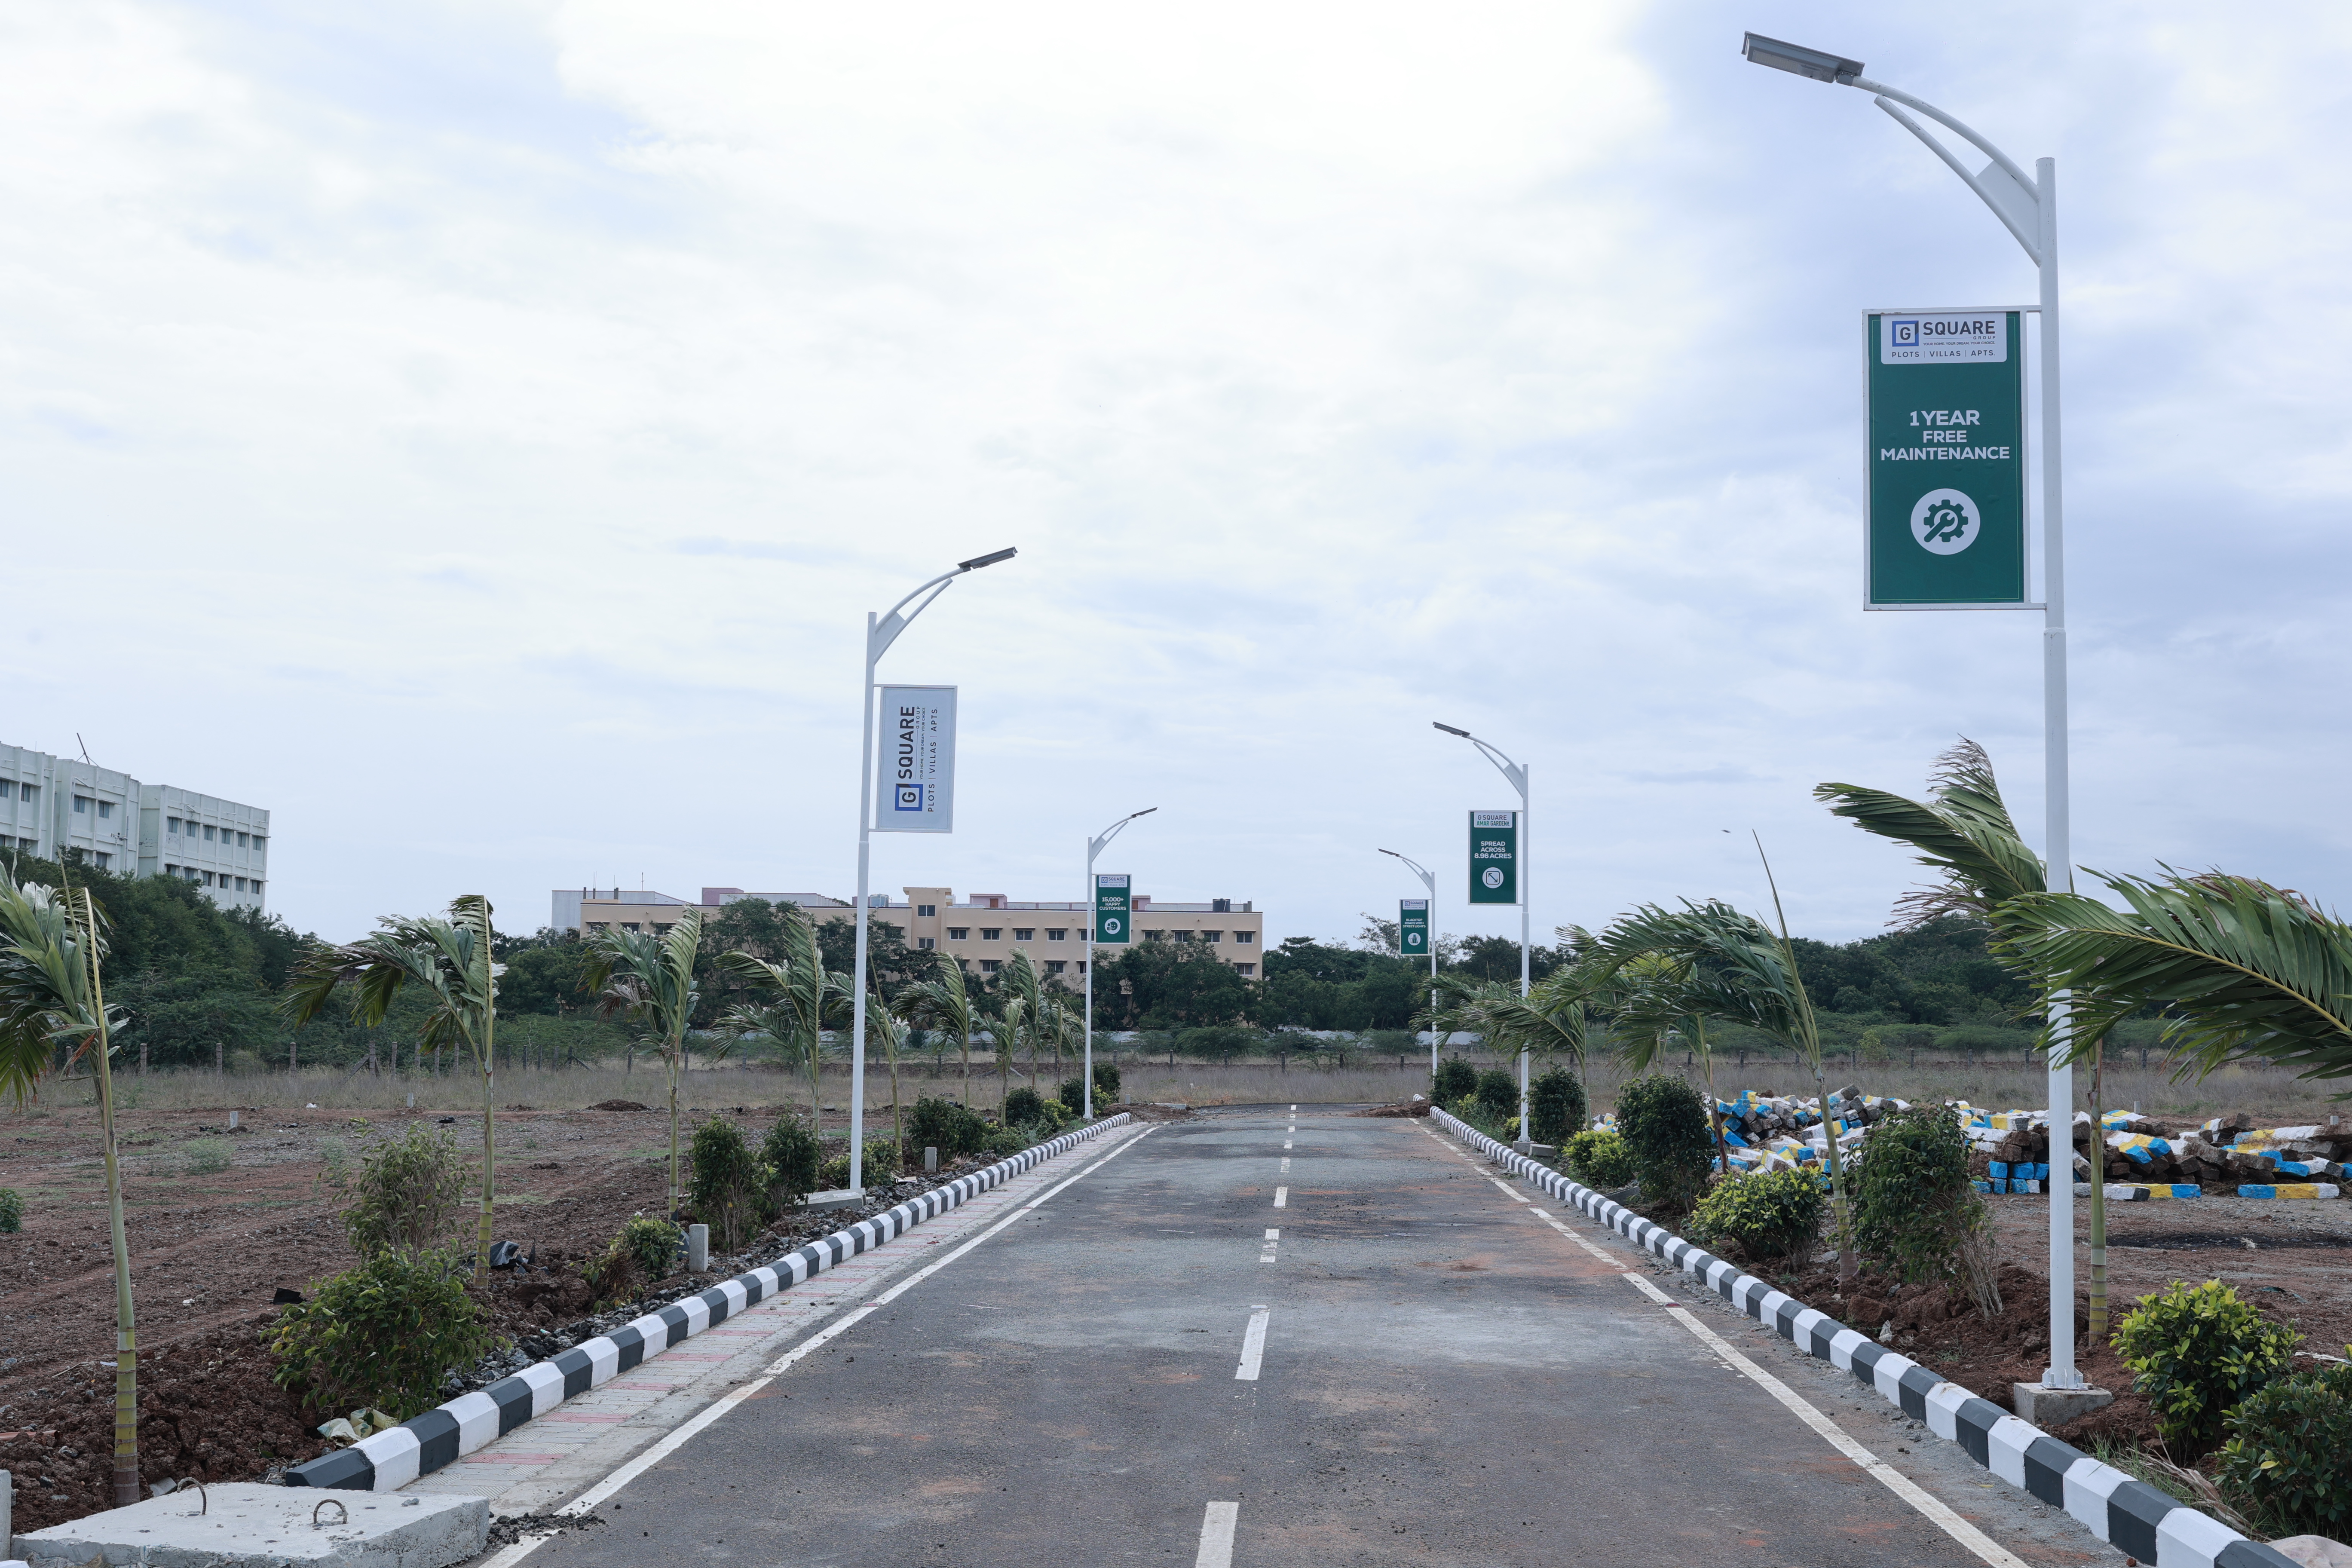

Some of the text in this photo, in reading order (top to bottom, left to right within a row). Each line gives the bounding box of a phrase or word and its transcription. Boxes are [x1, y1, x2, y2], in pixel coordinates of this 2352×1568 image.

[1900, 321, 1995, 340] G SQUARE
[1923, 431, 1967, 443] FREE
[1881, 447, 2010, 460] MAINTENANCE
[898, 706, 916, 803] G SQUARE
